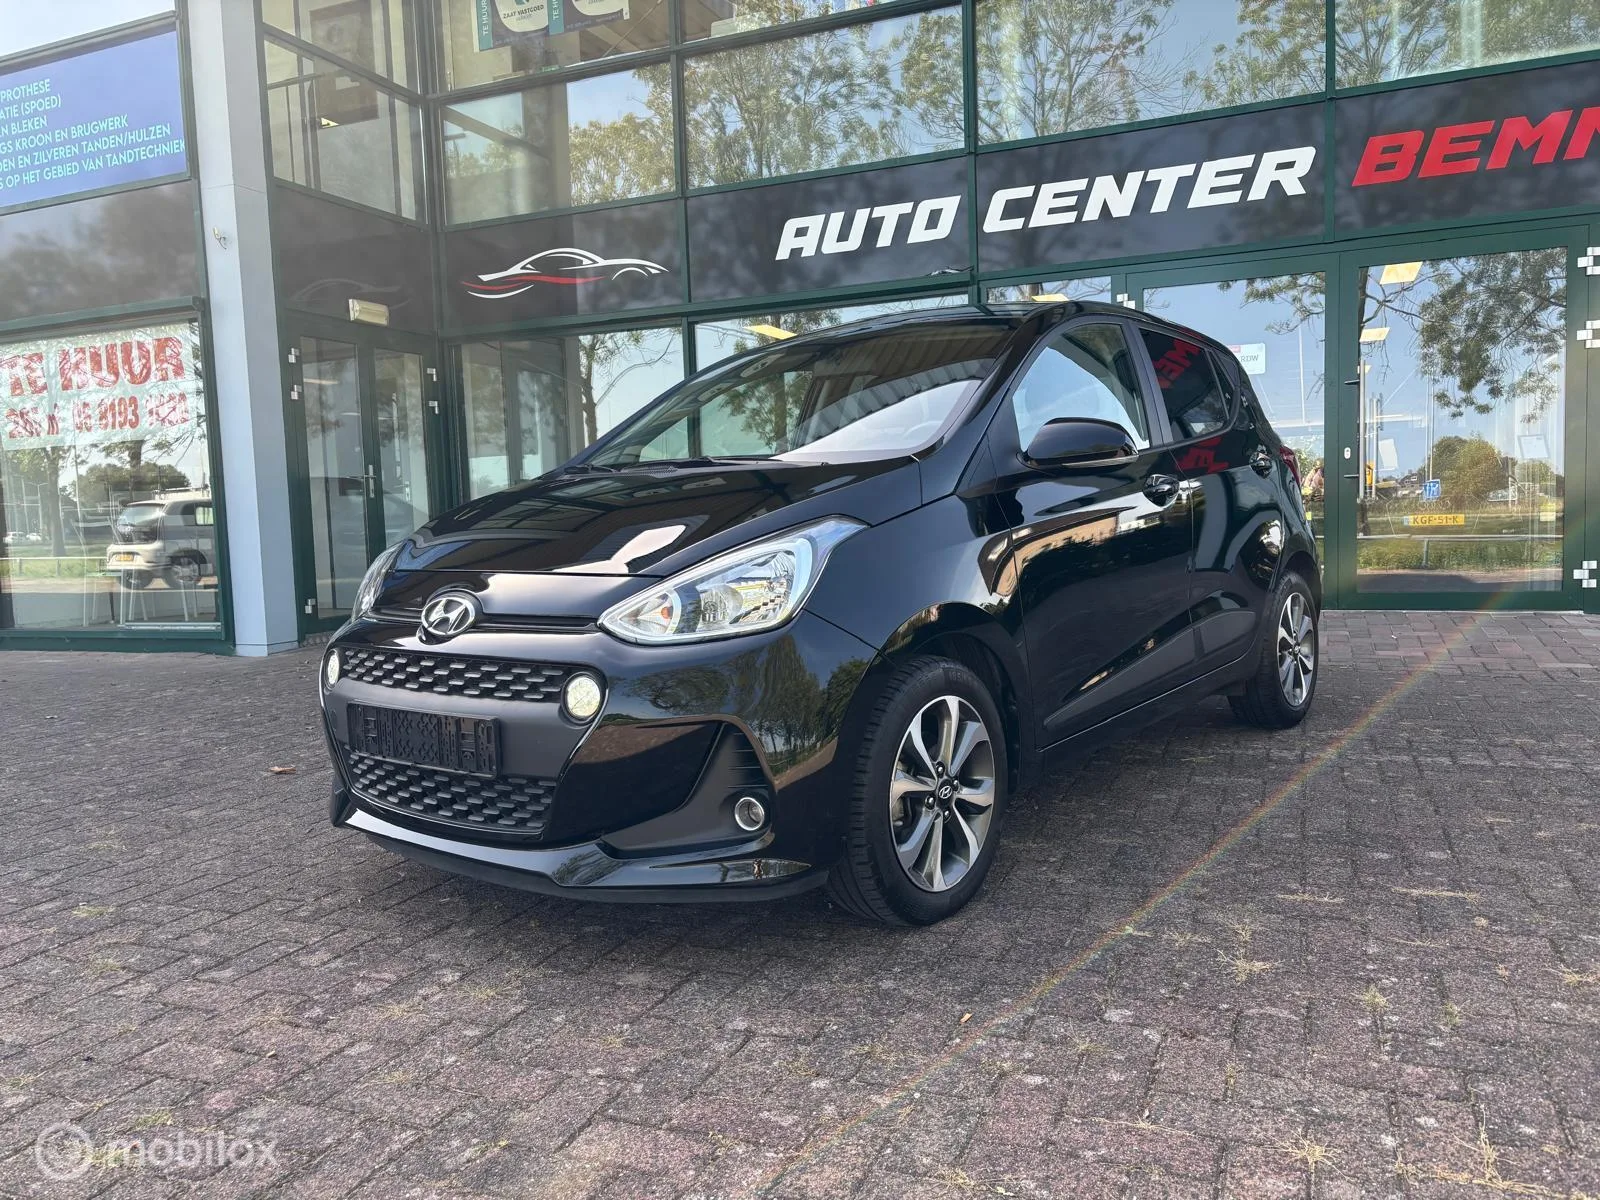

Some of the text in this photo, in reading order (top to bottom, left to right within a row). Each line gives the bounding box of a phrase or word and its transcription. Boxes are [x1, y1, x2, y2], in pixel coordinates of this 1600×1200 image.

[0, 79, 51, 102] PROTHESE
[21, 93, 61, 115] (SPOED)
[11, 115, 48, 135] BLEKEN
[15, 132, 52, 151] KROON
[55, 128, 68, 142] EN
[71, 114, 128, 139] BRUGWERK
[18, 154, 31, 168] EN
[33, 143, 79, 165] ZILVEREN
[81, 122, 171, 154] TANDEN/HULZEN
[6, 174, 20, 188] OP
[23, 169, 40, 184] HET
[43, 161, 80, 180] GEBIED
[82, 155, 104, 172] VAN
[775, 195, 961, 260] AUTO
[983, 146, 1316, 233] CENTER
[0, 336, 186, 397] TE HUUR
[1240, 354, 1259, 362] RDW
[1413, 515, 1458, 525] KGF-51-K
